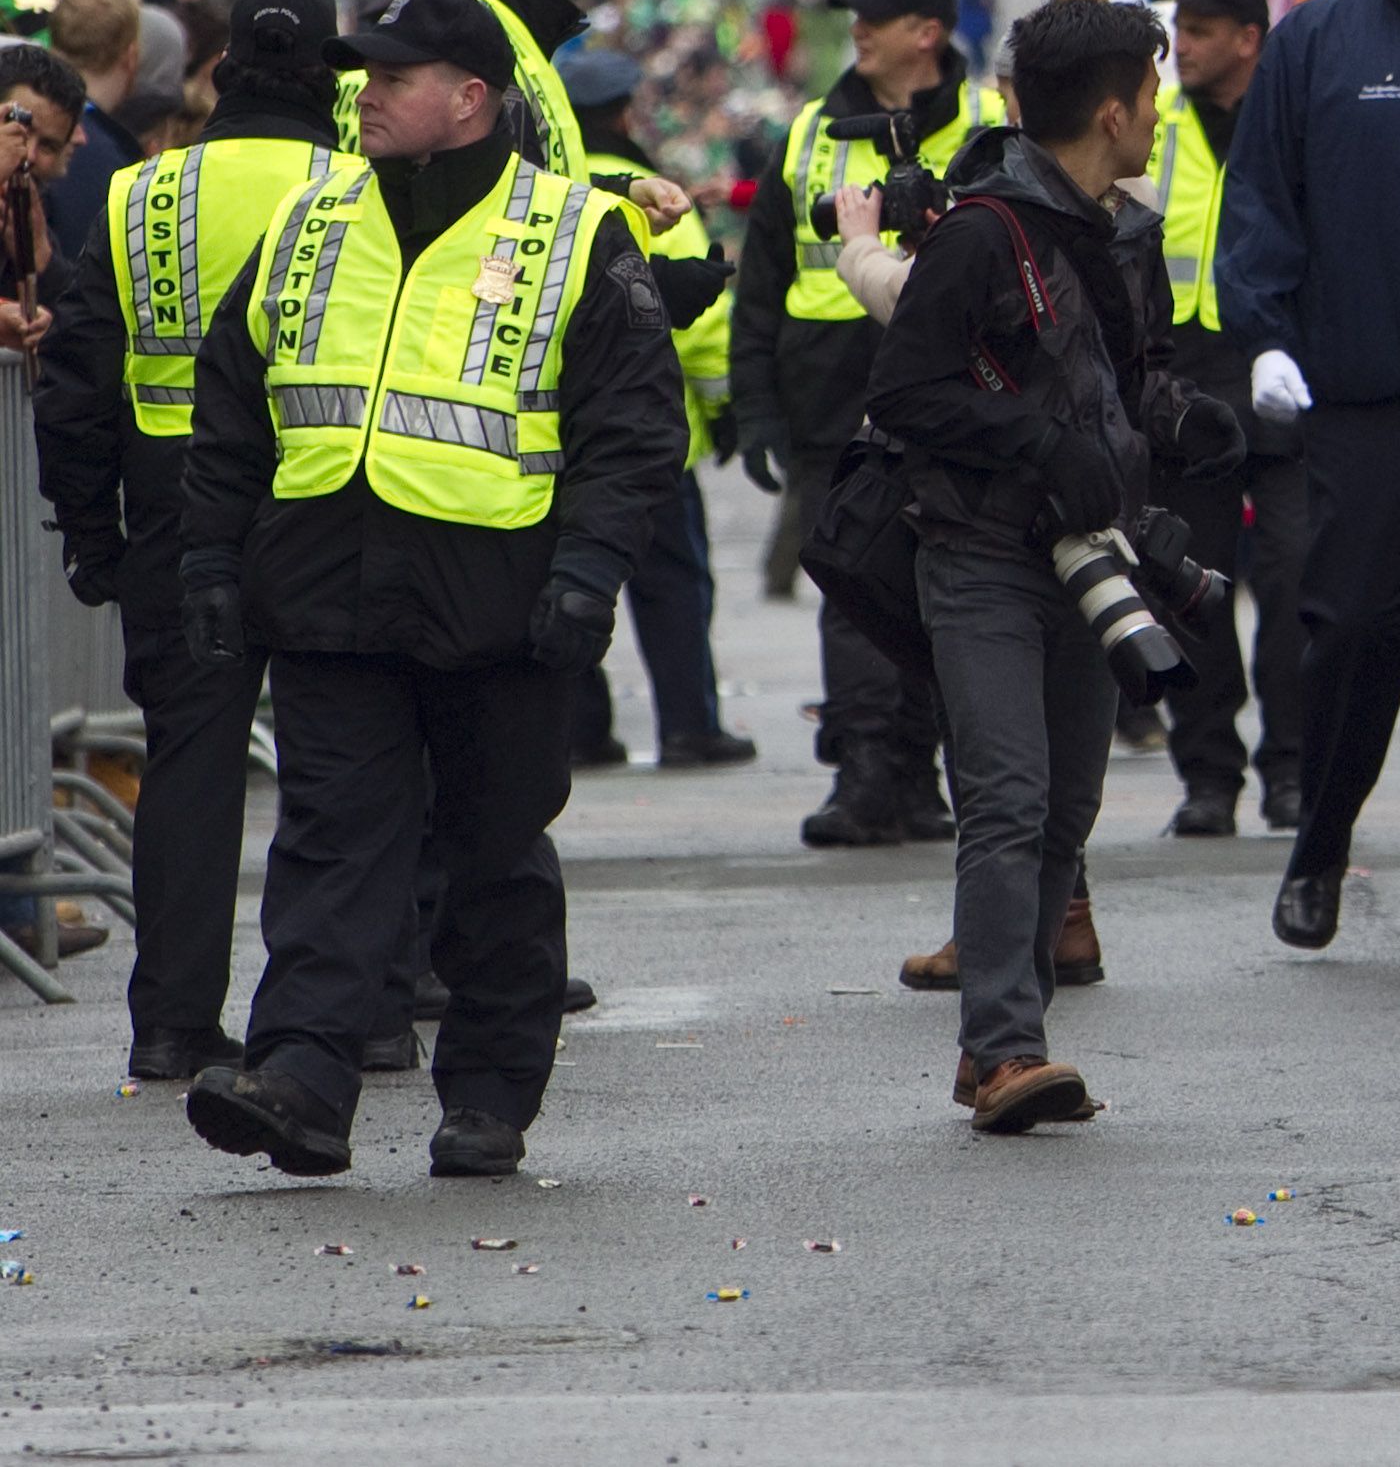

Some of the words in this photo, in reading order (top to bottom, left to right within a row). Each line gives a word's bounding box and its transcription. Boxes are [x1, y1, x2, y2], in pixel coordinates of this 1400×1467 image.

[151, 172, 177, 323] BOSTON
[278, 196, 338, 350] BOSTON
[490, 212, 554, 377] POLICE
[1023, 260, 1044, 313] Canon
[975, 357, 1004, 392] EOS
